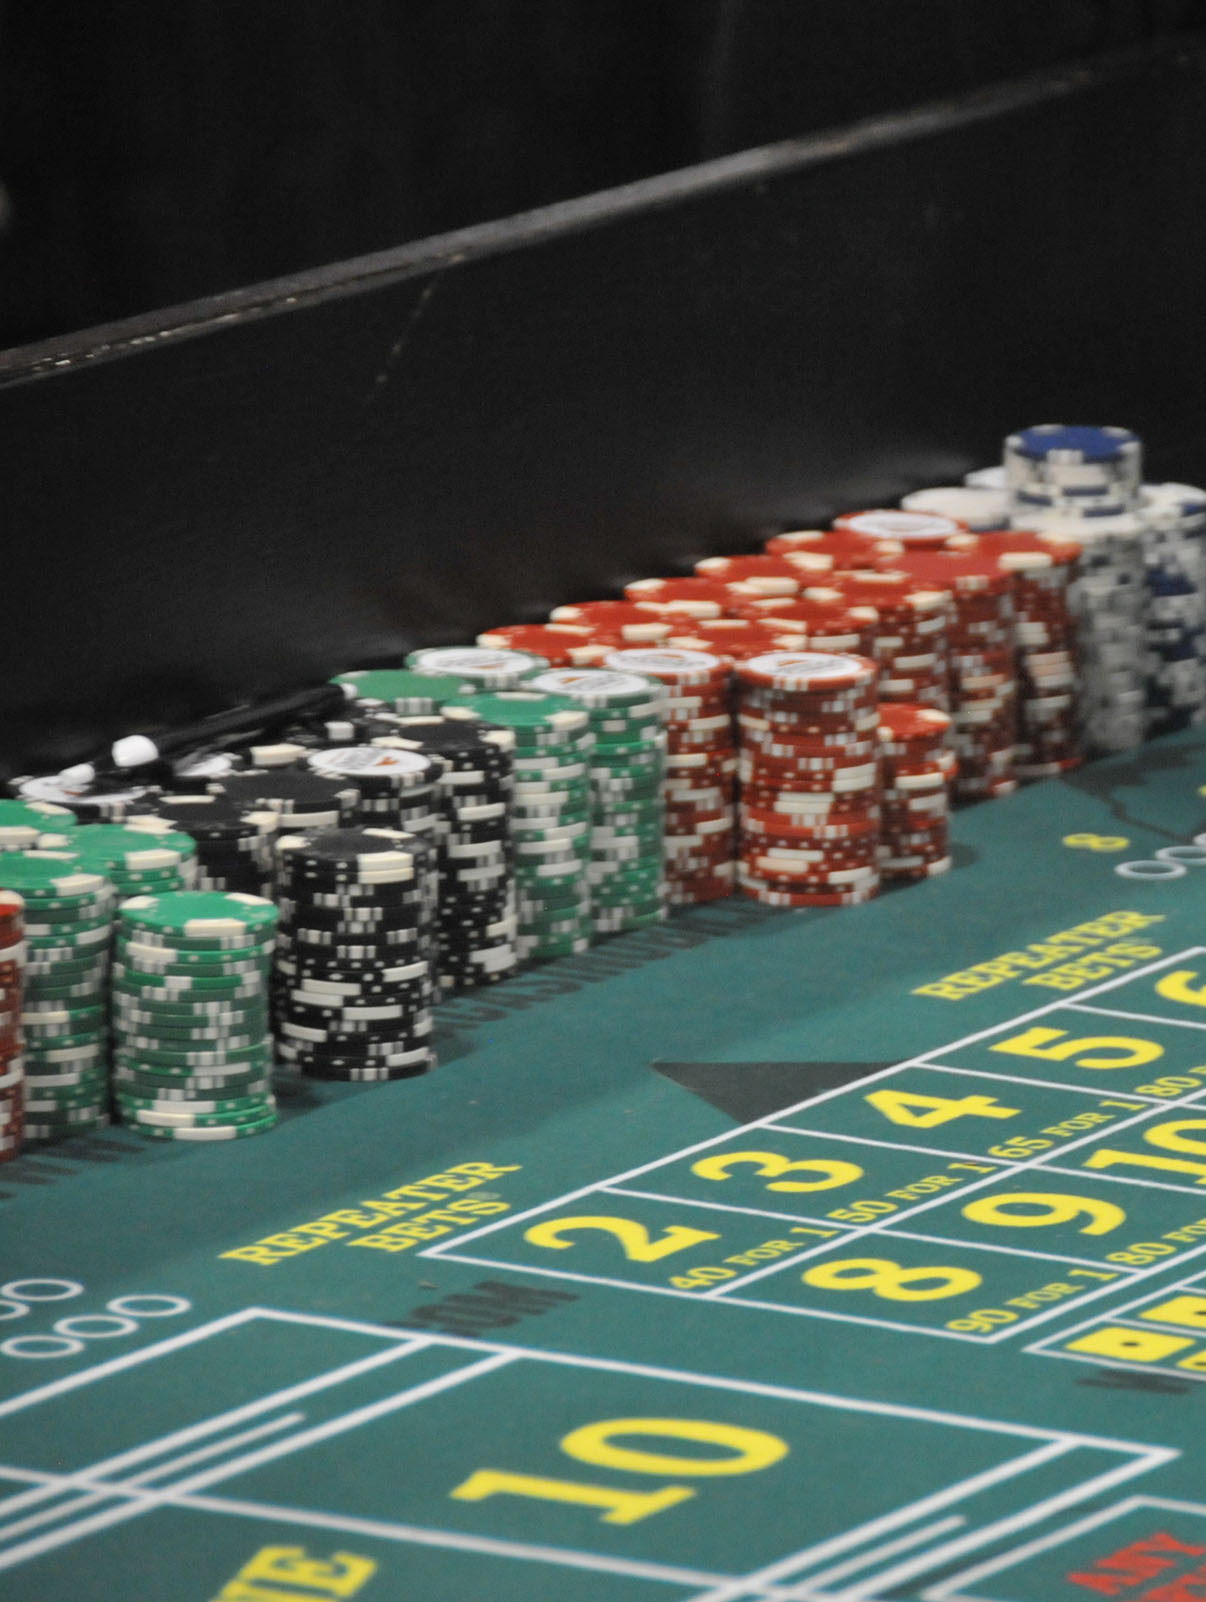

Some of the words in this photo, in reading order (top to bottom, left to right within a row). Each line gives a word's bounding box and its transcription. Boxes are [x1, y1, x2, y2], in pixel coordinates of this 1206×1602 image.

[1062, 832, 1130, 852] 8
[911, 909, 1166, 1001] REPEATER
[1022, 940, 1162, 991] BETS
[989, 1026, 1165, 1070] 5
[863, 1088, 1022, 1130] 4
[1134, 1076, 1202, 1097] 80
[987, 1135, 1054, 1159] 65
[1041, 1113, 1114, 1137] FOR
[1101, 1100, 1146, 1111] 1
[690, 1150, 865, 1194] 3
[826, 1199, 899, 1223] 50
[886, 1175, 963, 1200] FOR
[949, 1162, 995, 1174] 1
[217, 1161, 522, 1266] REPEATER
[346, 1197, 511, 1253] BETS
[960, 1191, 1127, 1237] 9
[523, 1214, 722, 1264] 2
[669, 1265, 738, 1290] 40
[724, 1240, 804, 1265] FOR
[790, 1227, 838, 1238] 1
[1105, 1241, 1178, 1267] 80
[800, 1256, 985, 1303] 8
[945, 1308, 1020, 1334] 90
[1007, 1282, 1083, 1310] FOR
[1069, 1269, 1118, 1281] 1
[449, 1417, 790, 1526] 10
